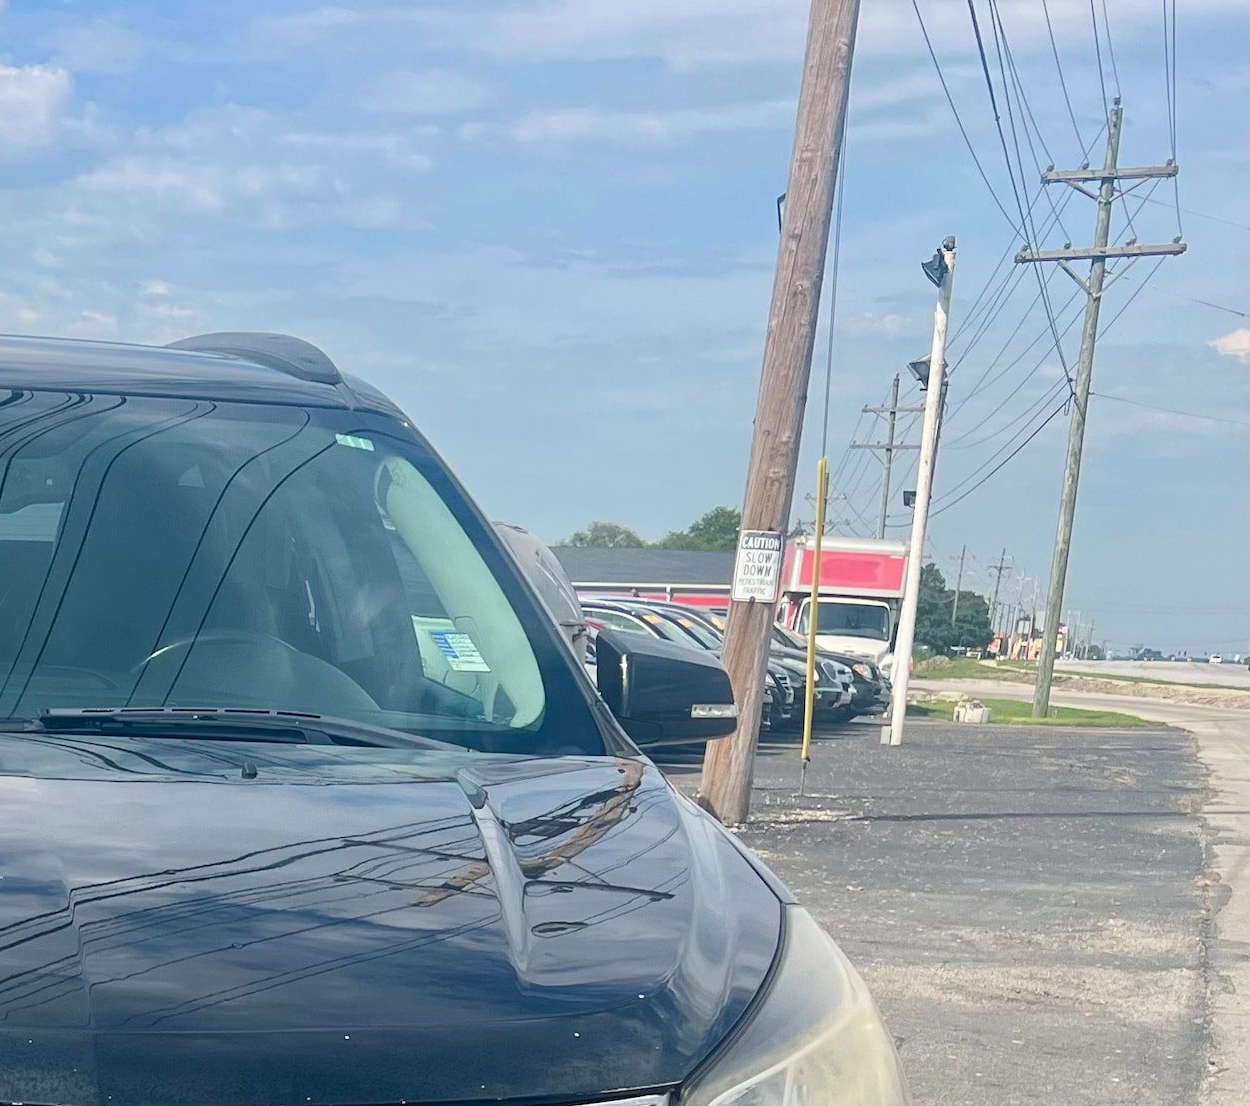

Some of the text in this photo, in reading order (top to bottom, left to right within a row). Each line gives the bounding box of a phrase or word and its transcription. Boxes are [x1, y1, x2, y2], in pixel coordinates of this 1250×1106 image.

[742, 536, 780, 550] CAUTION
[746, 551, 773, 564] SLOW
[743, 564, 771, 577] DOWN
[742, 586, 766, 595] TRAFFIC
